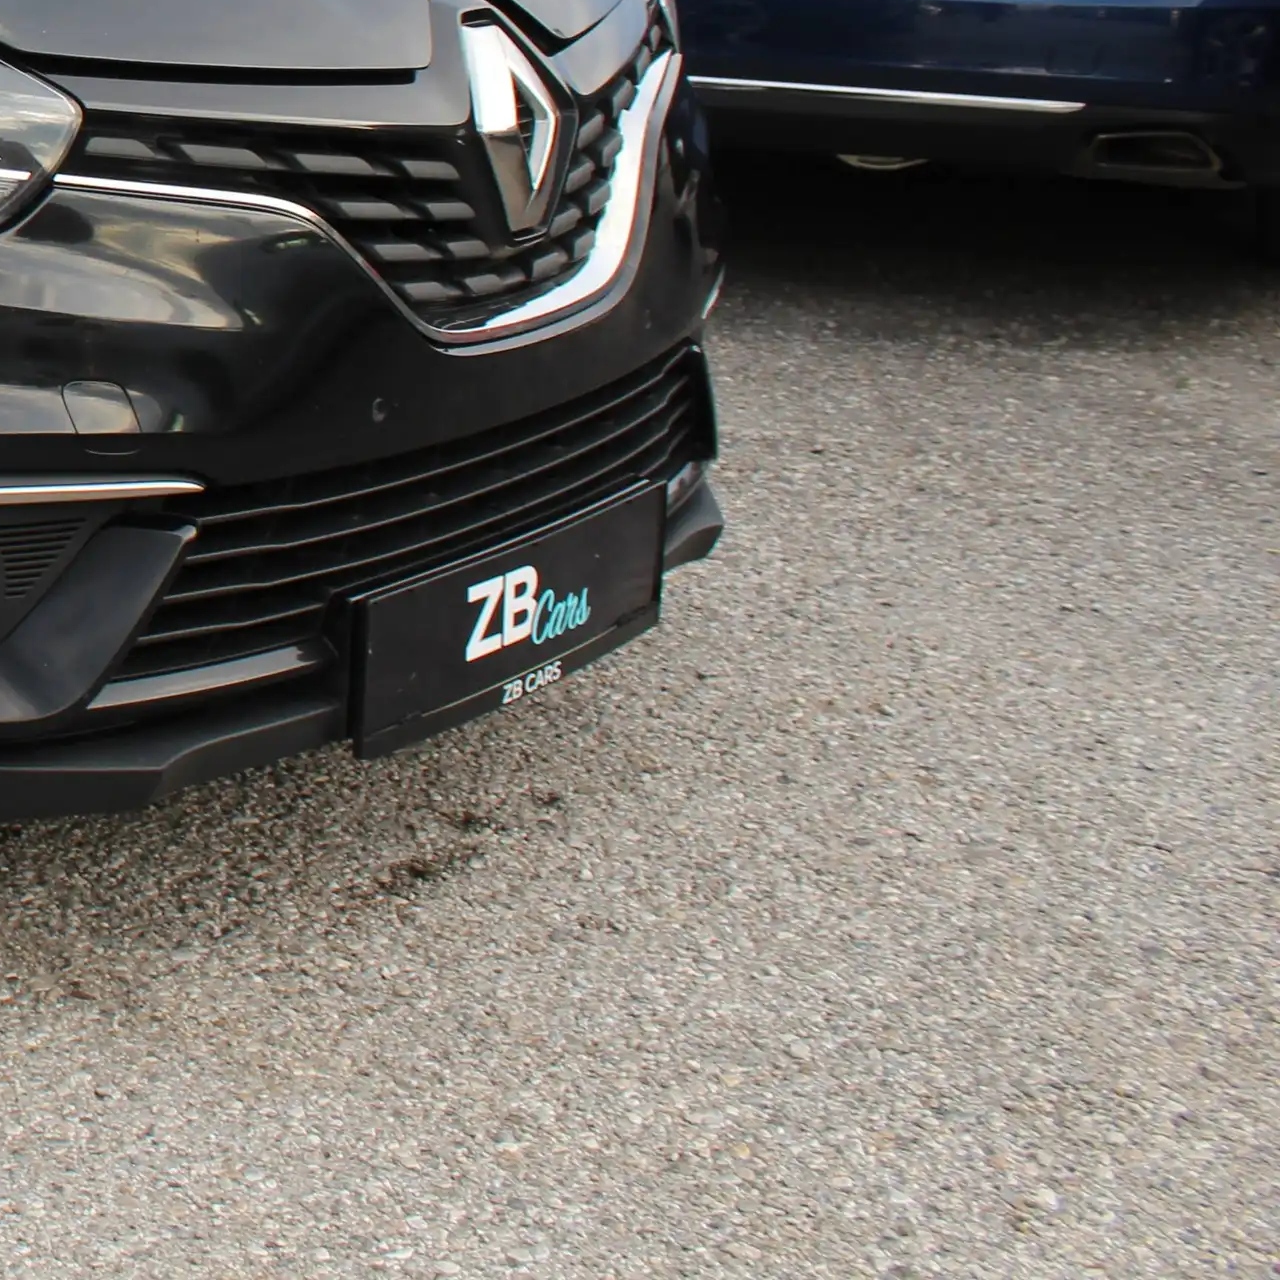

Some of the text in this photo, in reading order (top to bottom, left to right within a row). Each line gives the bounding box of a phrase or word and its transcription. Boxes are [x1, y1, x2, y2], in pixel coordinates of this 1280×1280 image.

[465, 565, 591, 662] ZB Cars
[502, 661, 562, 705] ZB CARS
